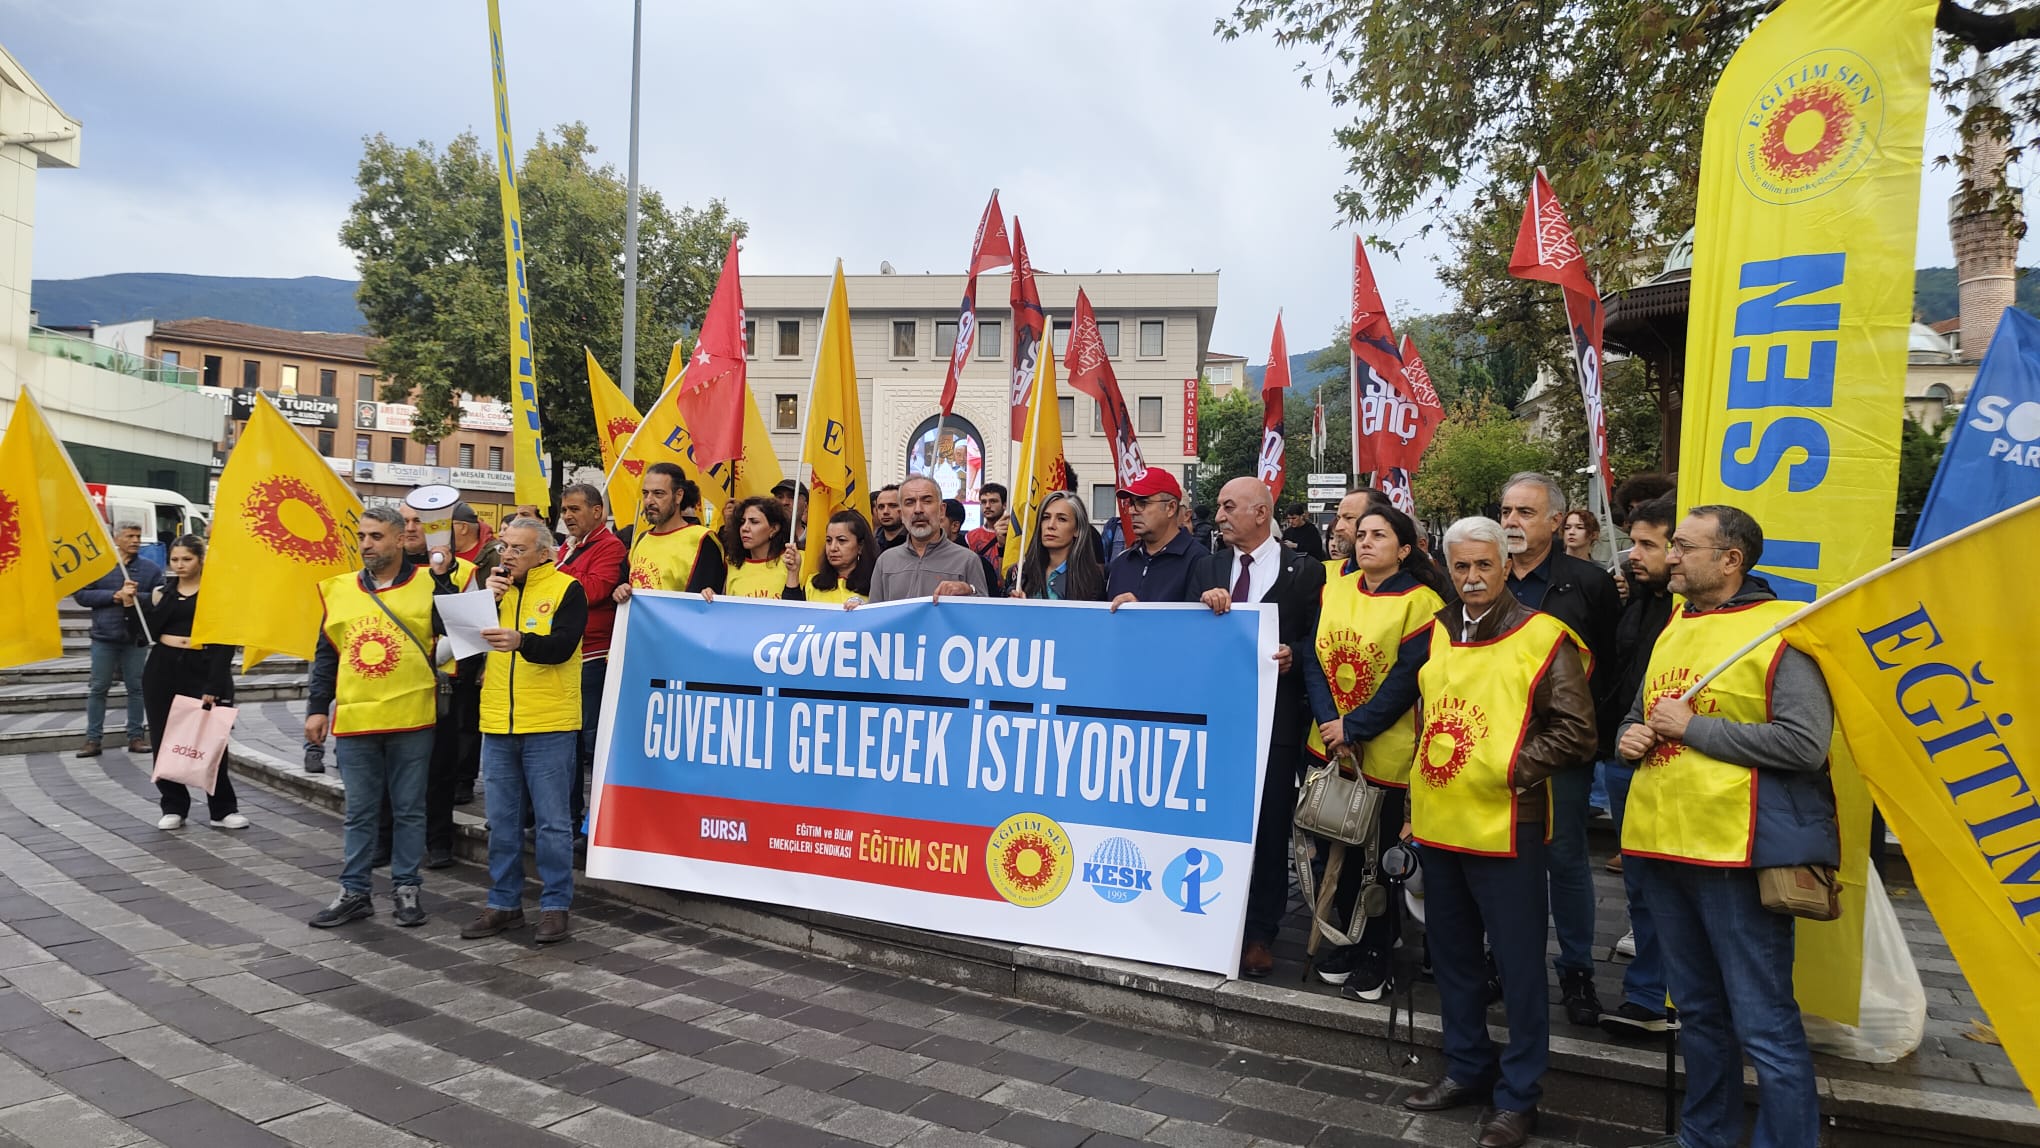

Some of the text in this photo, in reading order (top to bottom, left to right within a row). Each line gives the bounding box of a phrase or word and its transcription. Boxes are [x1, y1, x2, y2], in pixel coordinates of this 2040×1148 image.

[1749, 64, 1875, 128] EĞİTİM SEN
[1720, 252, 1846, 492] SEN
[285, 398, 338, 414] TURİZM
[938, 634, 1067, 691] OKUL
[1318, 628, 1391, 674] ĞİTİM SEN
[1468, 704, 1490, 739] SEN
[643, 679, 1208, 812] GÜVENLİ GELECEK İSTİYORUZ!
[700, 818, 748, 842] BURSA
[823, 829, 833, 839] ve
[992, 818, 1069, 856] EĞİTİM SEN
[926, 841, 969, 875] SEN
[1082, 862, 1152, 891] KESK
[1107, 890, 1127, 901] 1995
